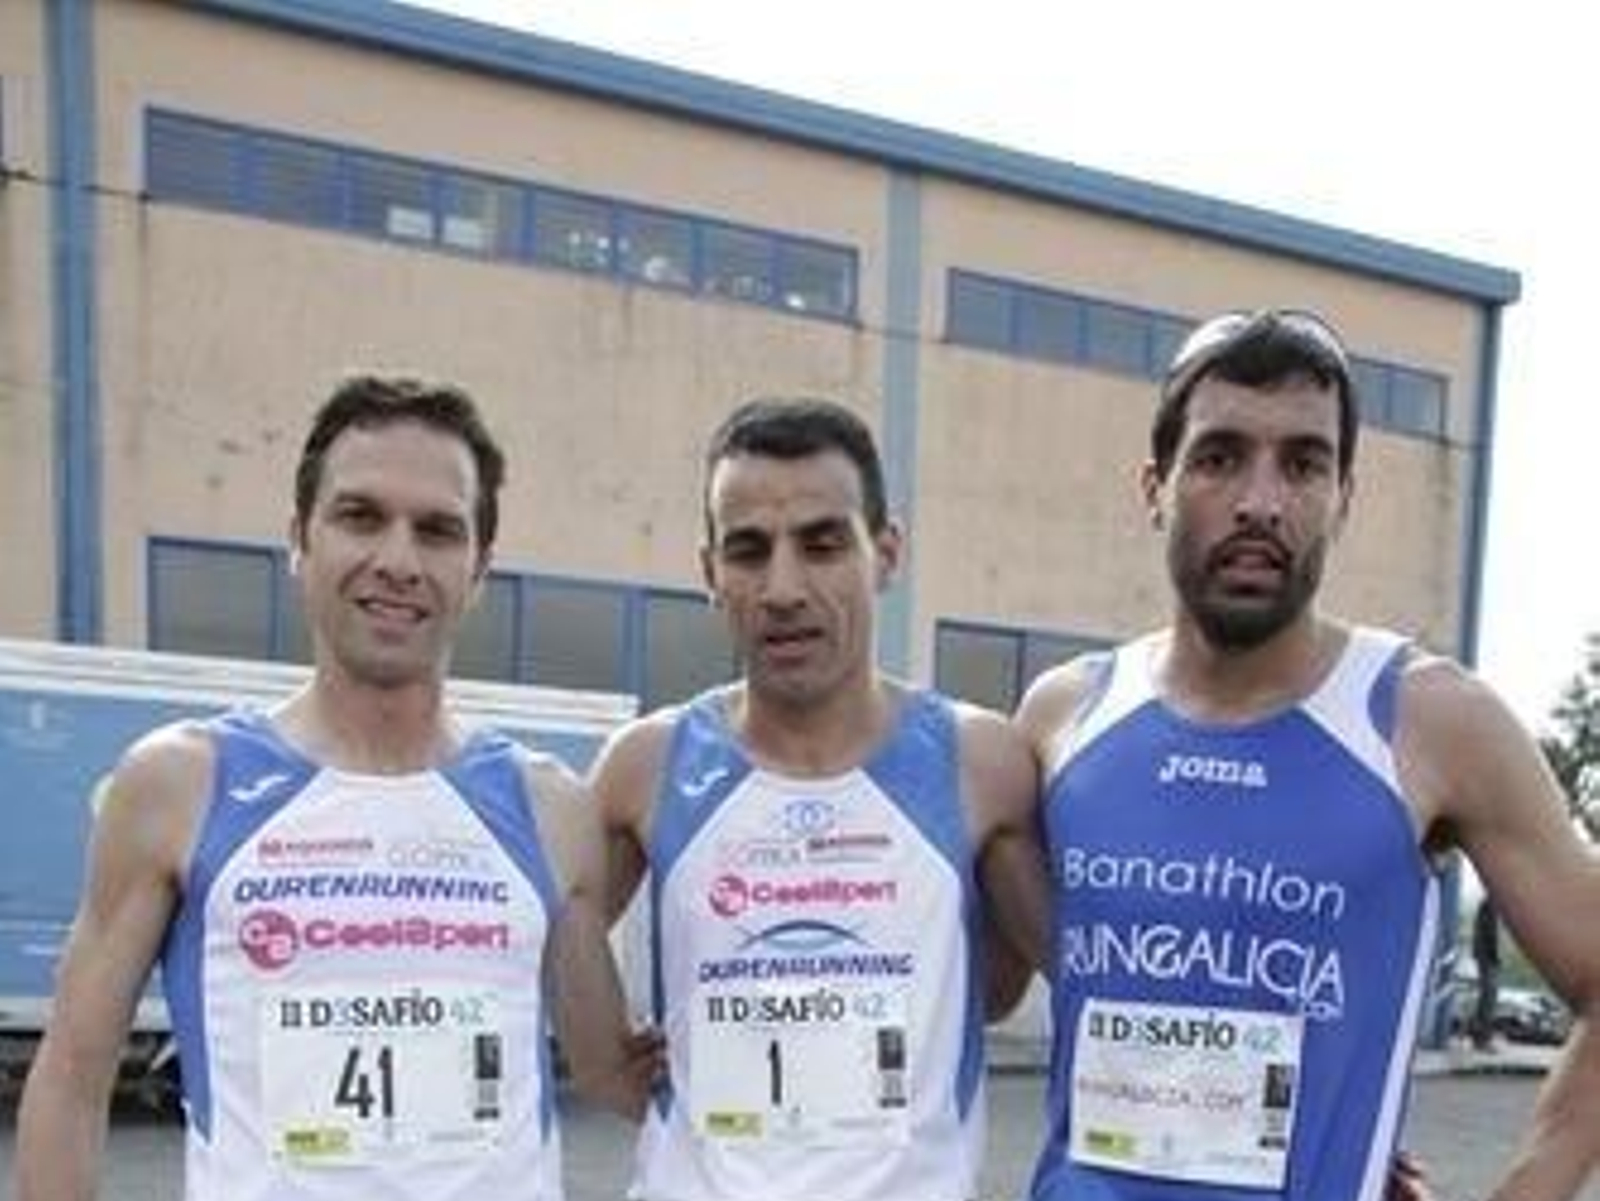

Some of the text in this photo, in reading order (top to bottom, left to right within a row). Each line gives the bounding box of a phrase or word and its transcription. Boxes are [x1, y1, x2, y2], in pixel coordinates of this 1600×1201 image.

[1063, 847, 1346, 920] Banathlon
[334, 1046, 393, 1119] 41
[768, 1040, 783, 1105] 1
